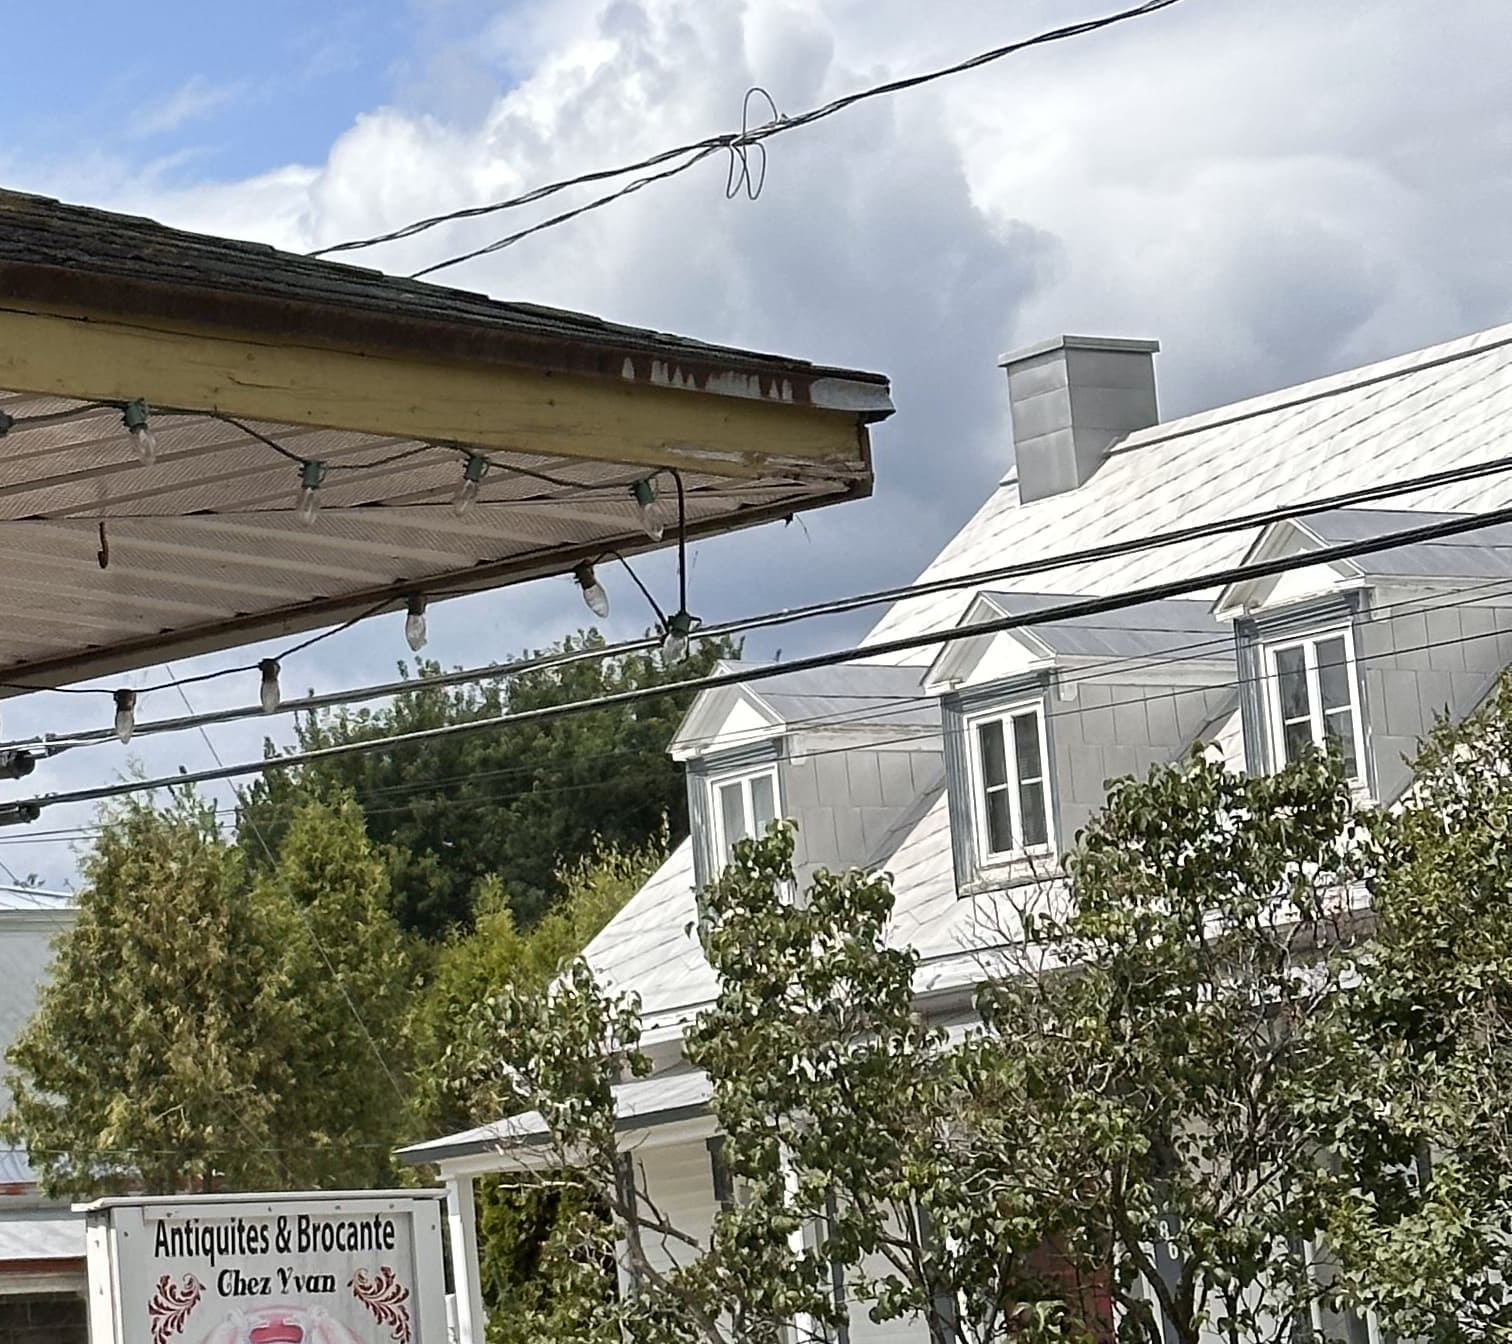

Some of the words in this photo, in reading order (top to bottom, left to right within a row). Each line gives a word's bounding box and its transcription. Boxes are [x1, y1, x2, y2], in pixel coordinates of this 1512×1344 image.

[154, 1217, 269, 1267] Antiquites
[275, 1215, 292, 1254] &
[297, 1214, 396, 1253] Brocante
[217, 1269, 272, 1297] Chez
[277, 1267, 337, 1293] Yvan
